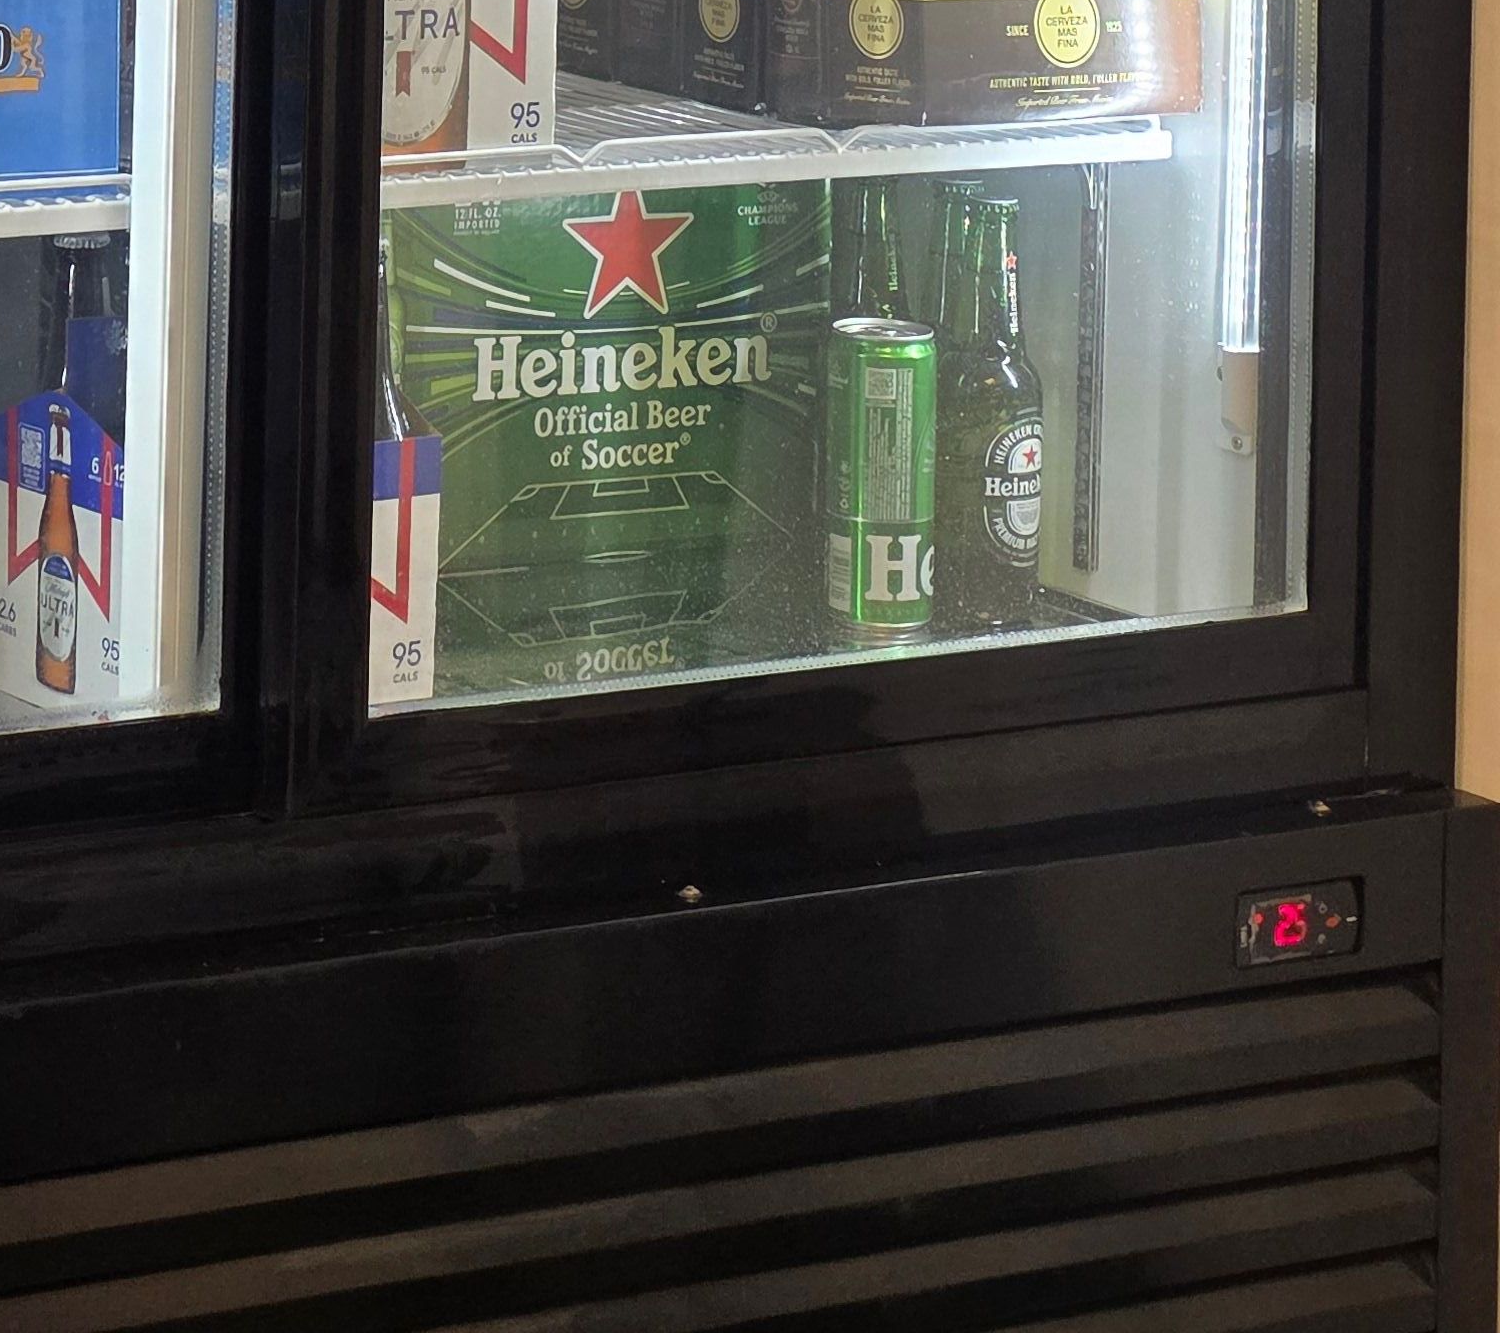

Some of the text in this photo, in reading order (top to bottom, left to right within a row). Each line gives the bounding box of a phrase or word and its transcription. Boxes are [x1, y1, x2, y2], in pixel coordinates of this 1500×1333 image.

[869, 5, 883, 15] LA
[1059, 5, 1074, 15] LA
[857, 14, 895, 25] CERVEZA
[1045, 16, 1089, 27] CERVEZA
[866, 24, 886, 34] MAS
[1005, 24, 1030, 37] SINCE
[1057, 27, 1078, 38] MAS
[865, 33, 886, 44] FINA
[1056, 38, 1079, 49] FINA
[509, 101, 541, 130] 95
[510, 133, 539, 145] CALS
[737, 201, 798, 217] CHAMPIONS
[453, 218, 501, 231] IMPORTED
[747, 213, 788, 227] LEAGUE
[471, 325, 772, 403] Heineken
[534, 400, 711, 438] Official Beer
[549, 437, 680, 471] of Soccer
[90, 455, 101, 475] 6
[40, 592, 76, 620] ULTRA
[101, 635, 120, 662] 95
[391, 640, 422, 669] 95
[100, 661, 120, 676] CALS
[392, 670, 419, 683] CALS
